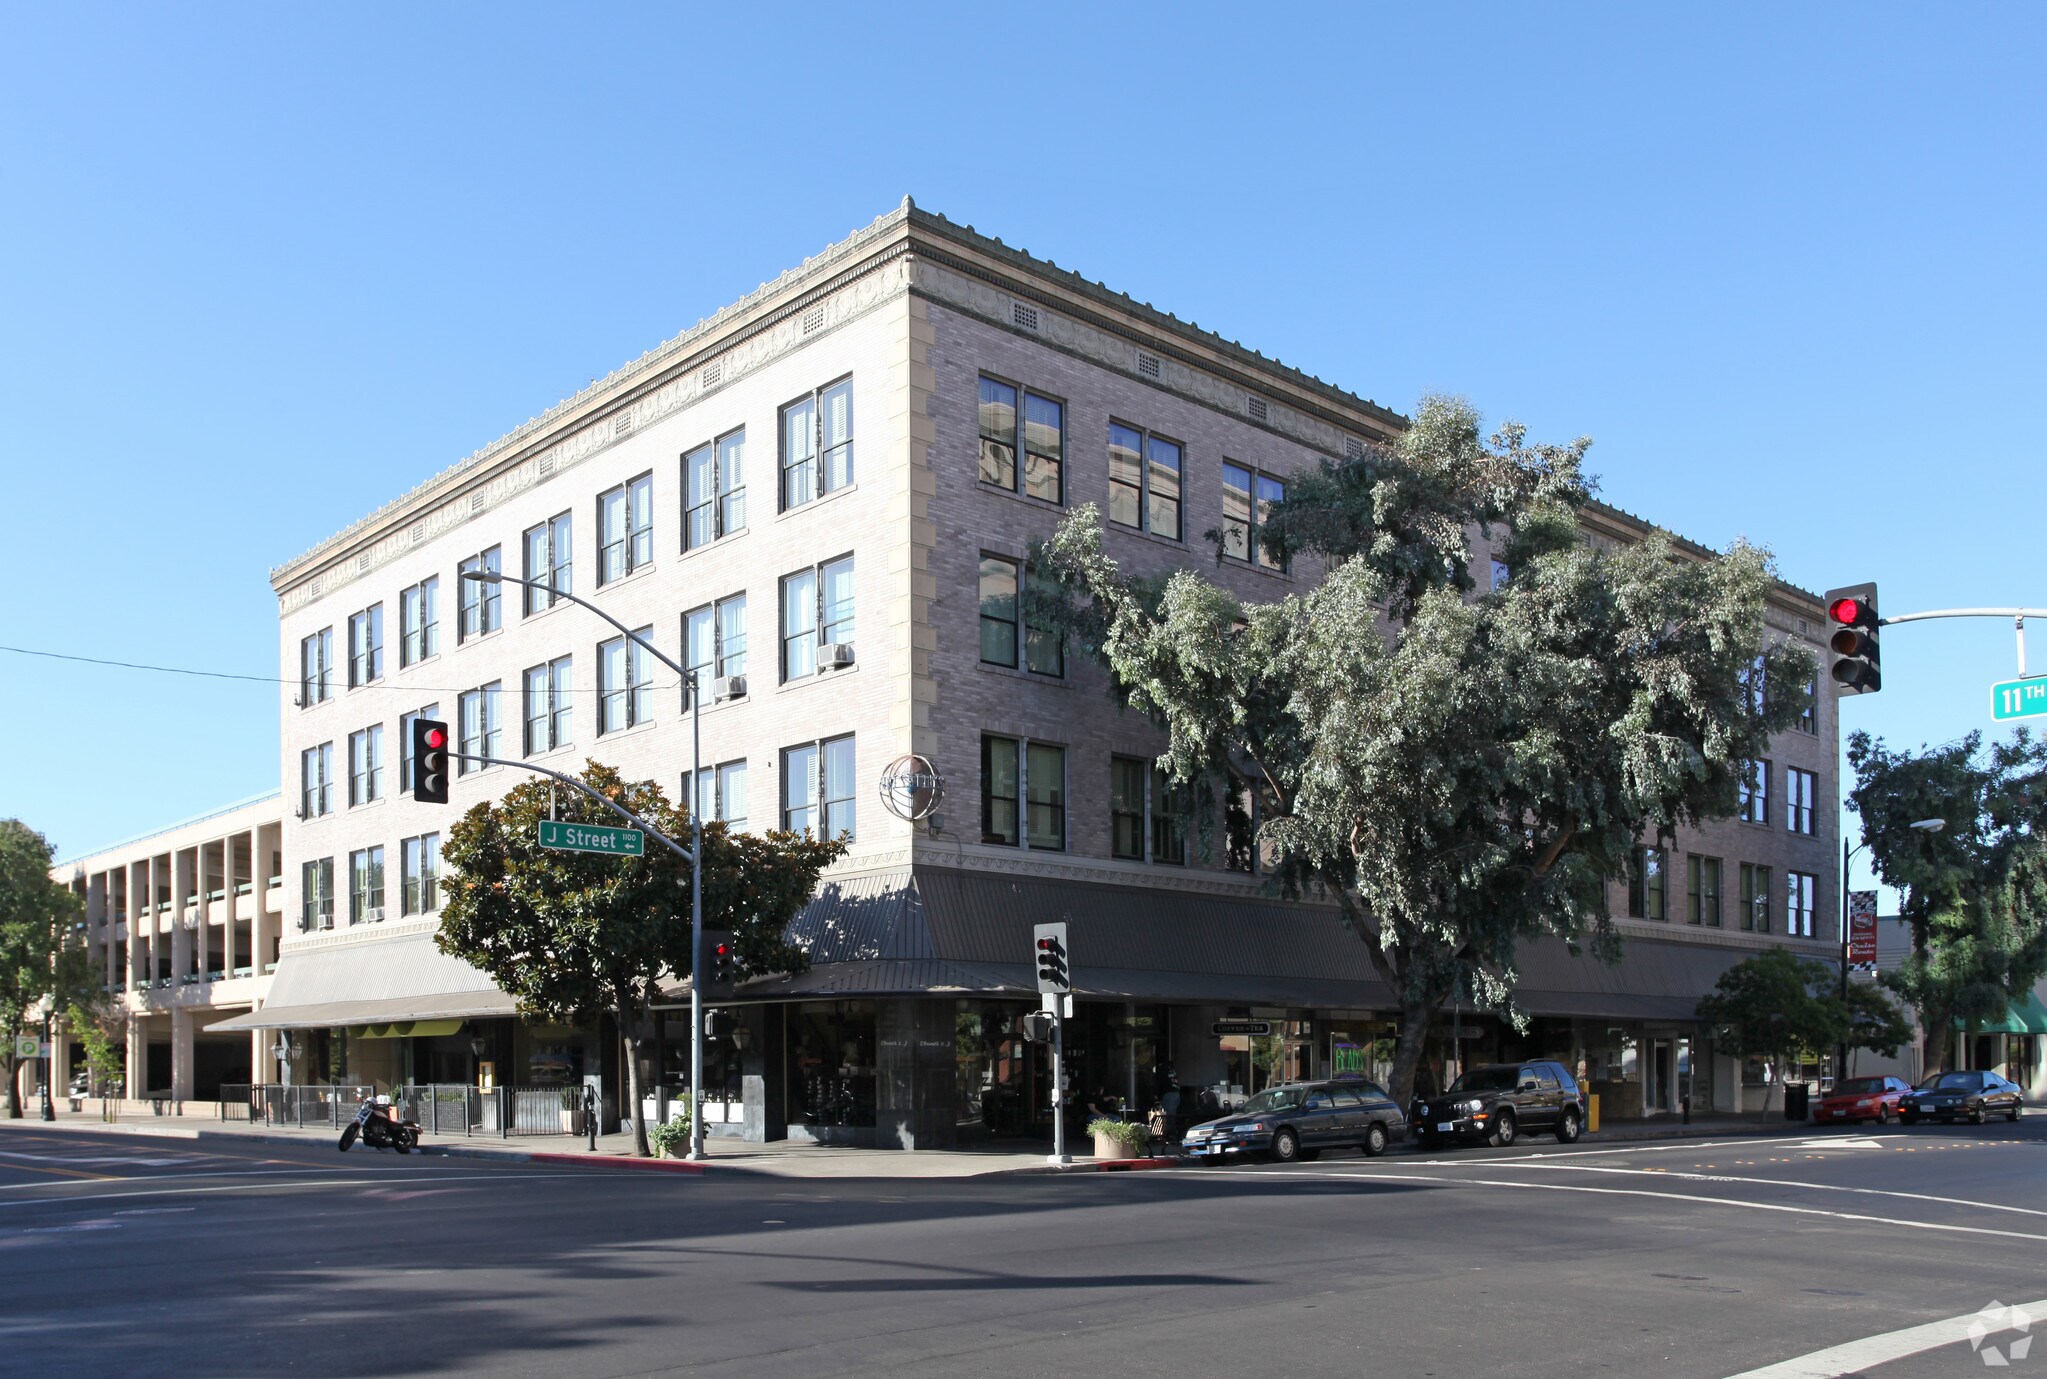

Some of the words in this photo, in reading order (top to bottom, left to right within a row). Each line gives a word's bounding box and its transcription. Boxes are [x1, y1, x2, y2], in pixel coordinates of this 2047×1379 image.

[2002, 685, 2045, 713] 11TH
[547, 827, 557, 843] J
[566, 828, 616, 849] Street
[622, 834, 637, 842] 1100
